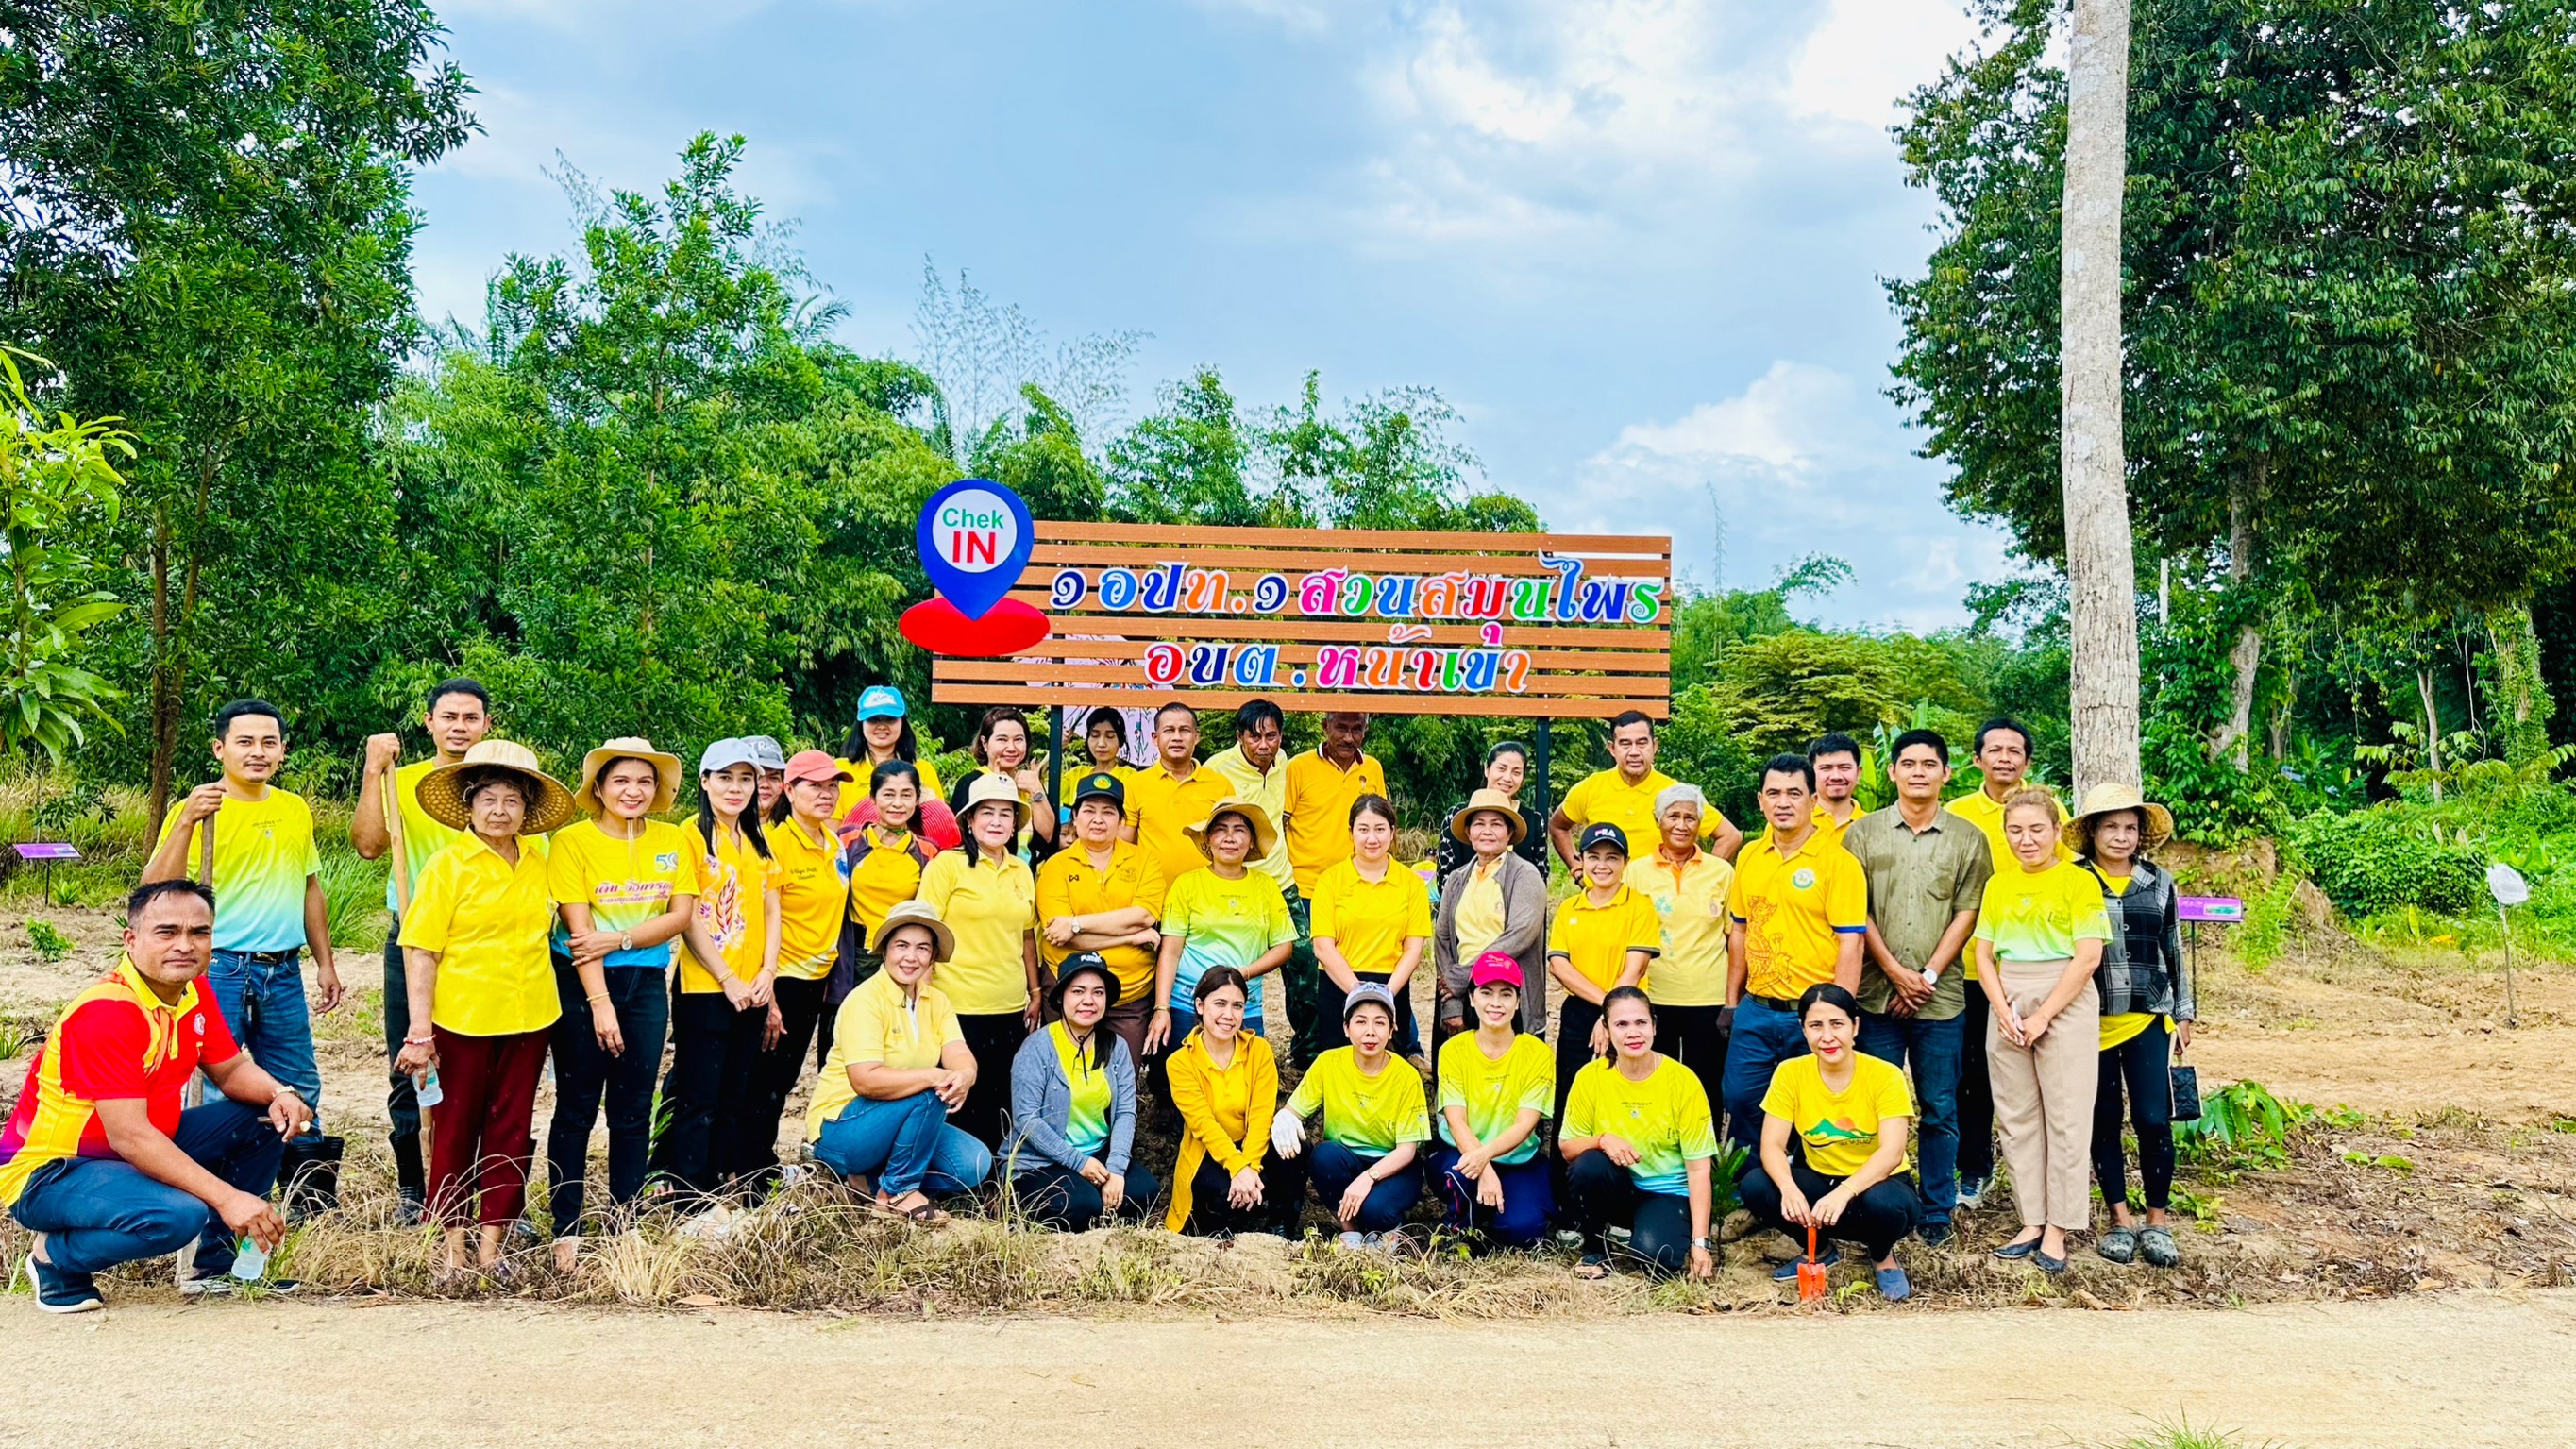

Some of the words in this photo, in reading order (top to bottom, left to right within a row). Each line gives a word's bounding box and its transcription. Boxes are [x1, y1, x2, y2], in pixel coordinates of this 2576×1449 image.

[942, 507, 1004, 529] Chek
[952, 531, 996, 564] IN
[1594, 828, 1616, 838] FILA
